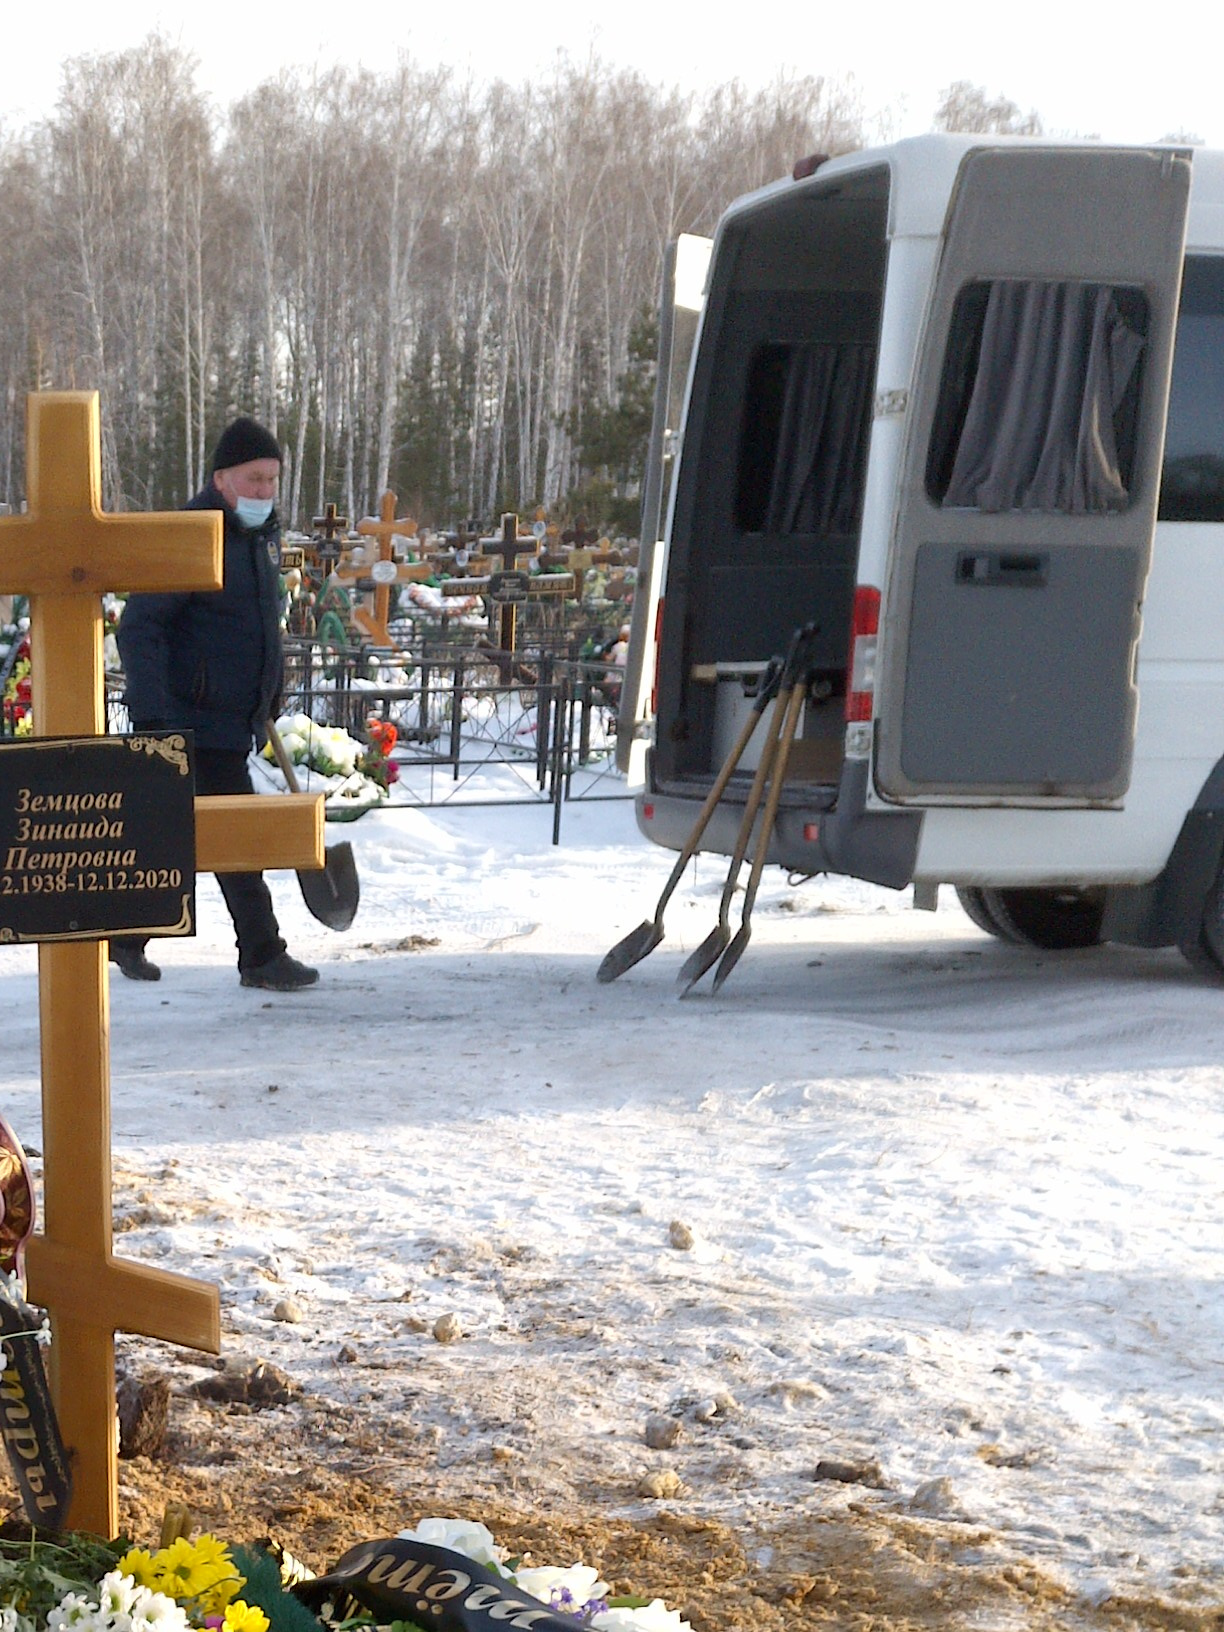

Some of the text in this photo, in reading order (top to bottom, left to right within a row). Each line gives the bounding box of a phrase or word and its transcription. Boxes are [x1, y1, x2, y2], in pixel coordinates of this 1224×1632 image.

[14, 788, 124, 816] Земцова
[15, 815, 125, 842] Зинаида
[4, 846, 137, 876] Петровна
